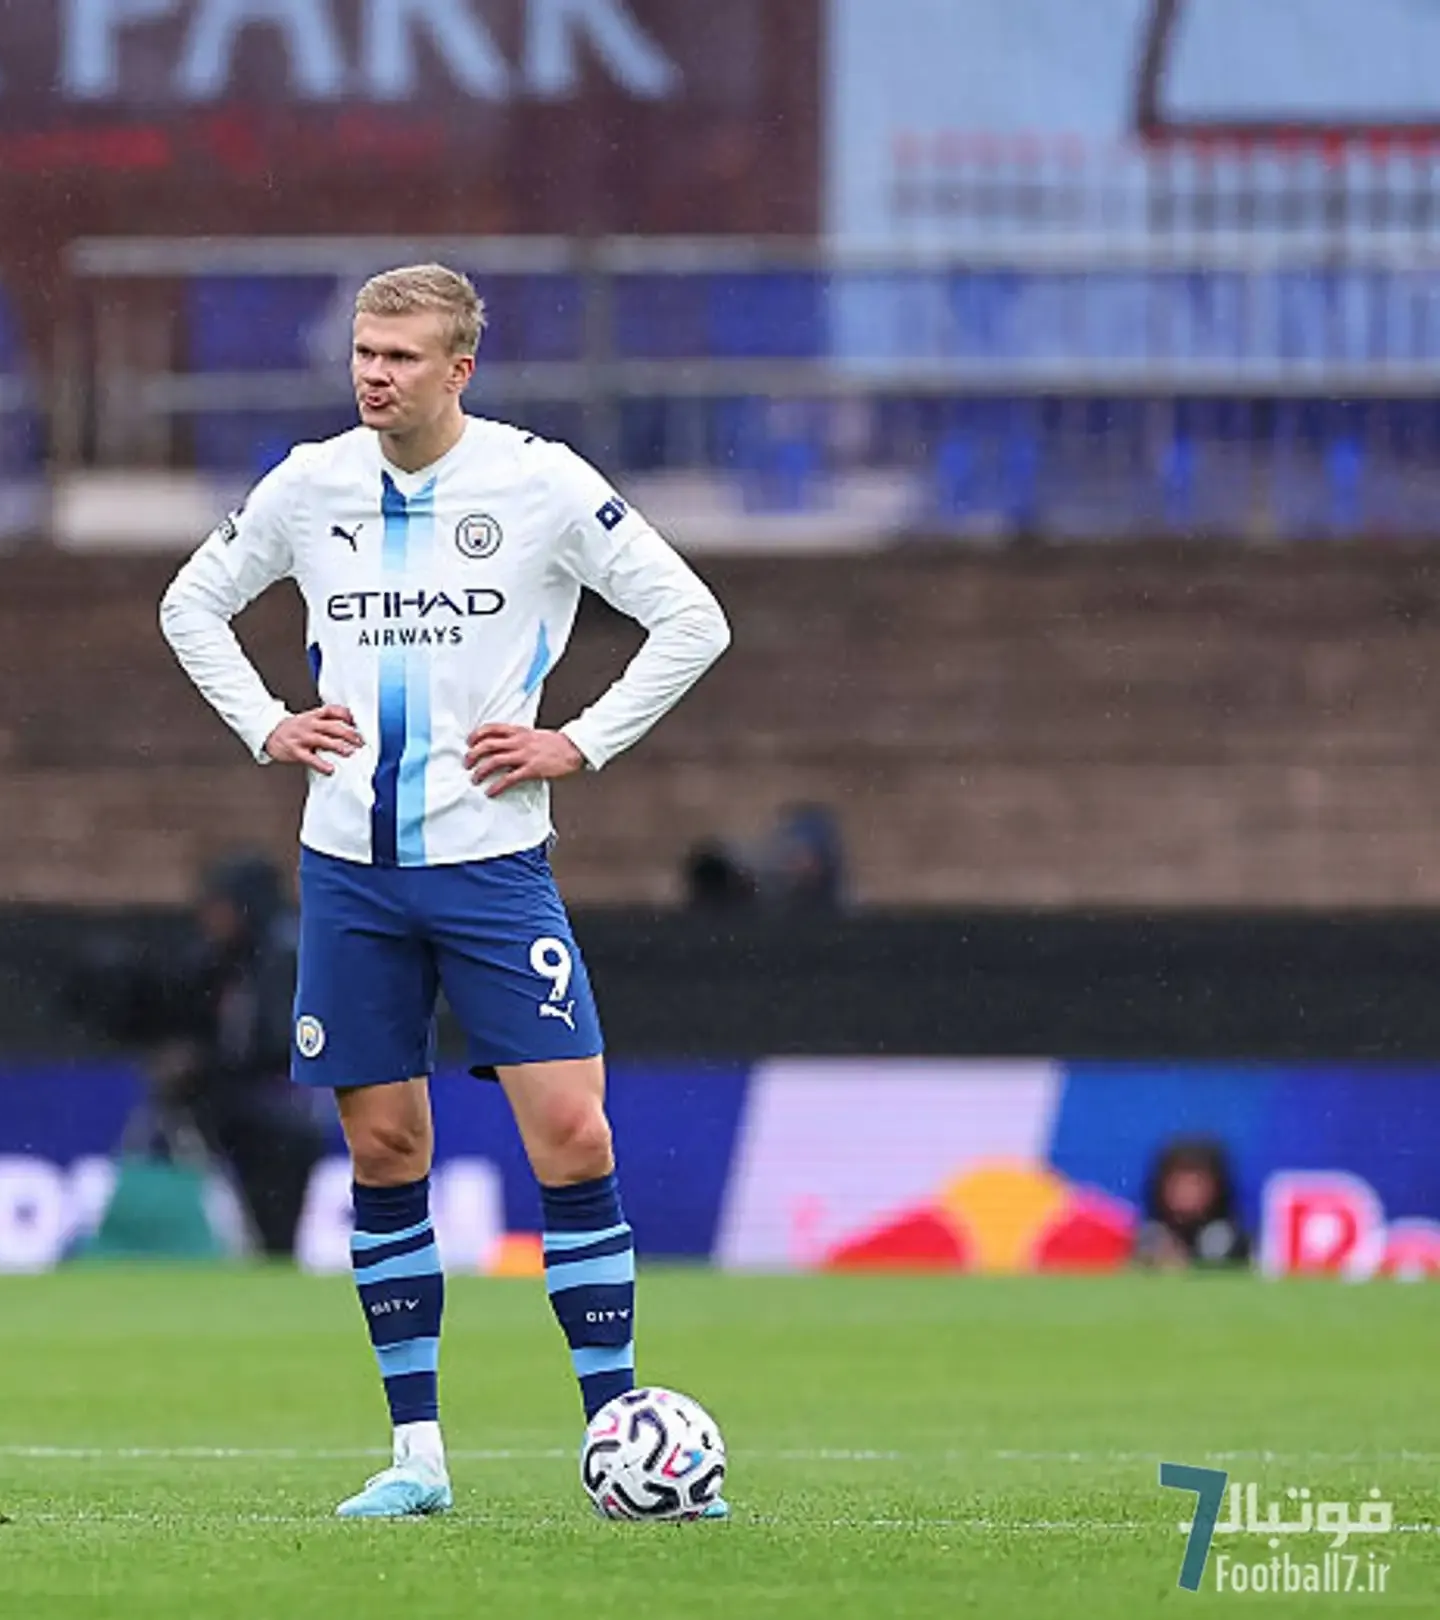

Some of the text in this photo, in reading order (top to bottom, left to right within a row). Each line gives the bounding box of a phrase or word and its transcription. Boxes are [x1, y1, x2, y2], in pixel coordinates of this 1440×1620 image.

[327, 588, 506, 621] ETIHAD
[358, 626, 463, 647] AIRWAYS
[530, 936, 573, 1002] 9
[371, 1298, 420, 1316] CITY
[586, 1308, 631, 1323] CITY
